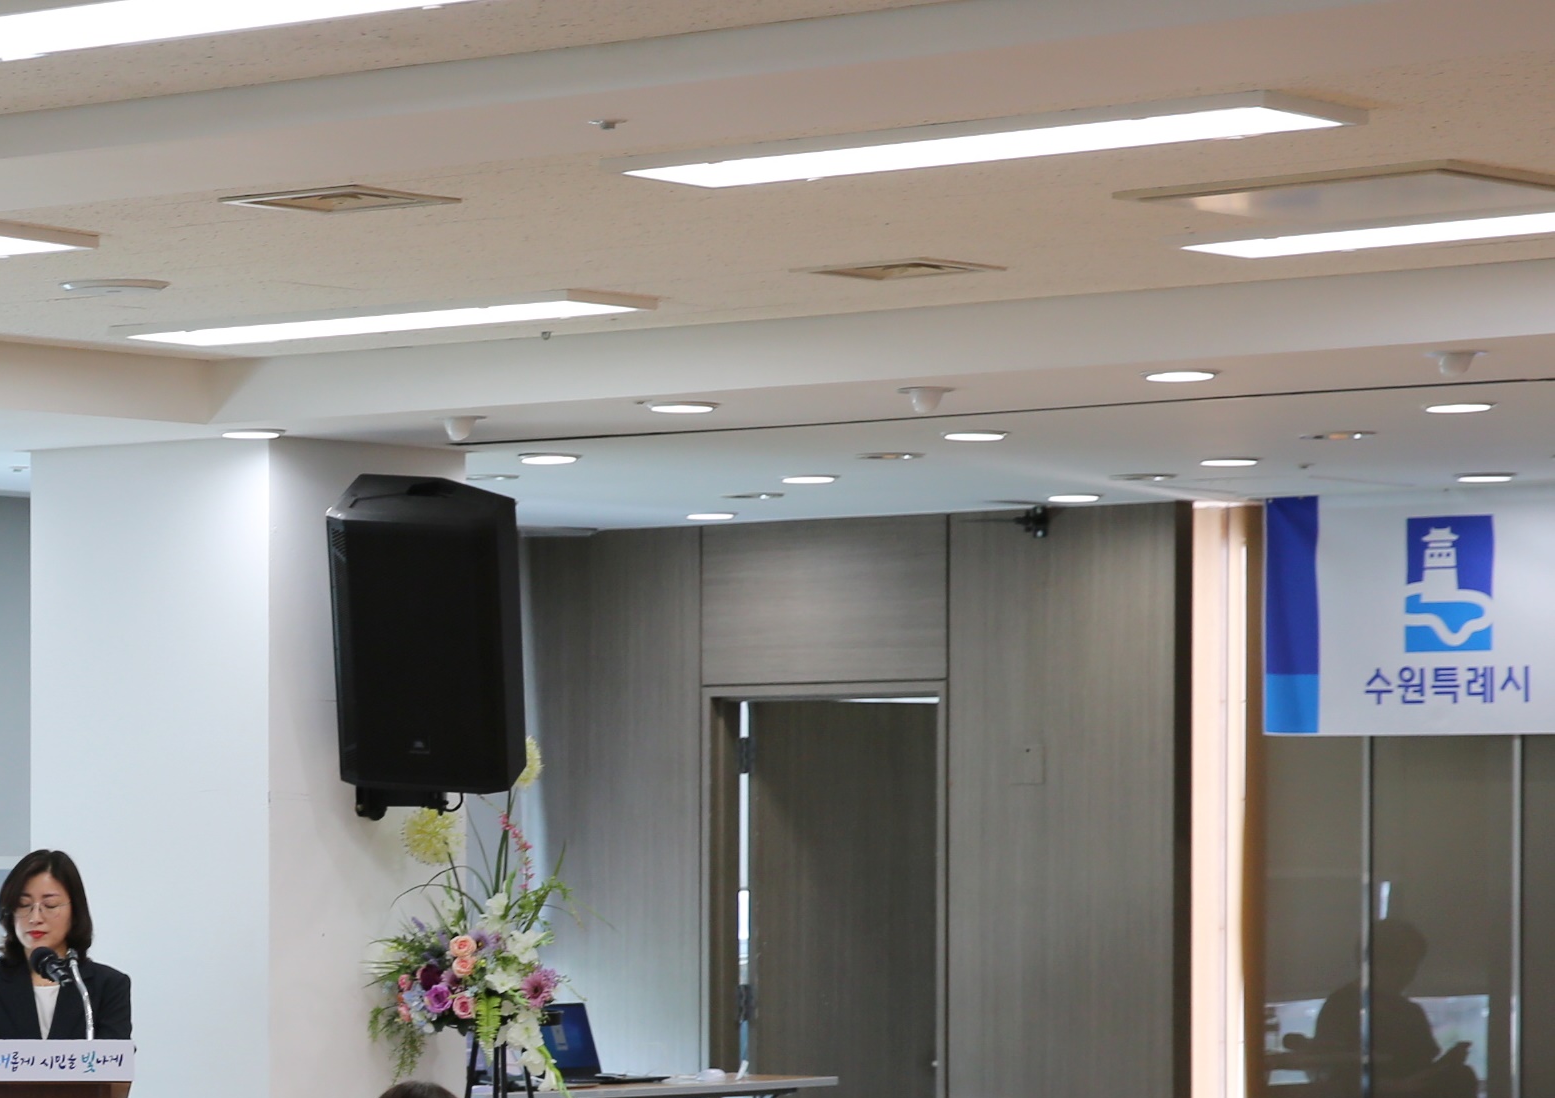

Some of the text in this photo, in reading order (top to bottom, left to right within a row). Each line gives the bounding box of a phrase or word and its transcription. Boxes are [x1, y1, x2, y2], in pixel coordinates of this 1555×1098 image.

[1364, 665, 1531, 705] 수원특례시
[40, 1052, 77, 1070] 시민을
[81, 1050, 124, 1073] 빛나게
